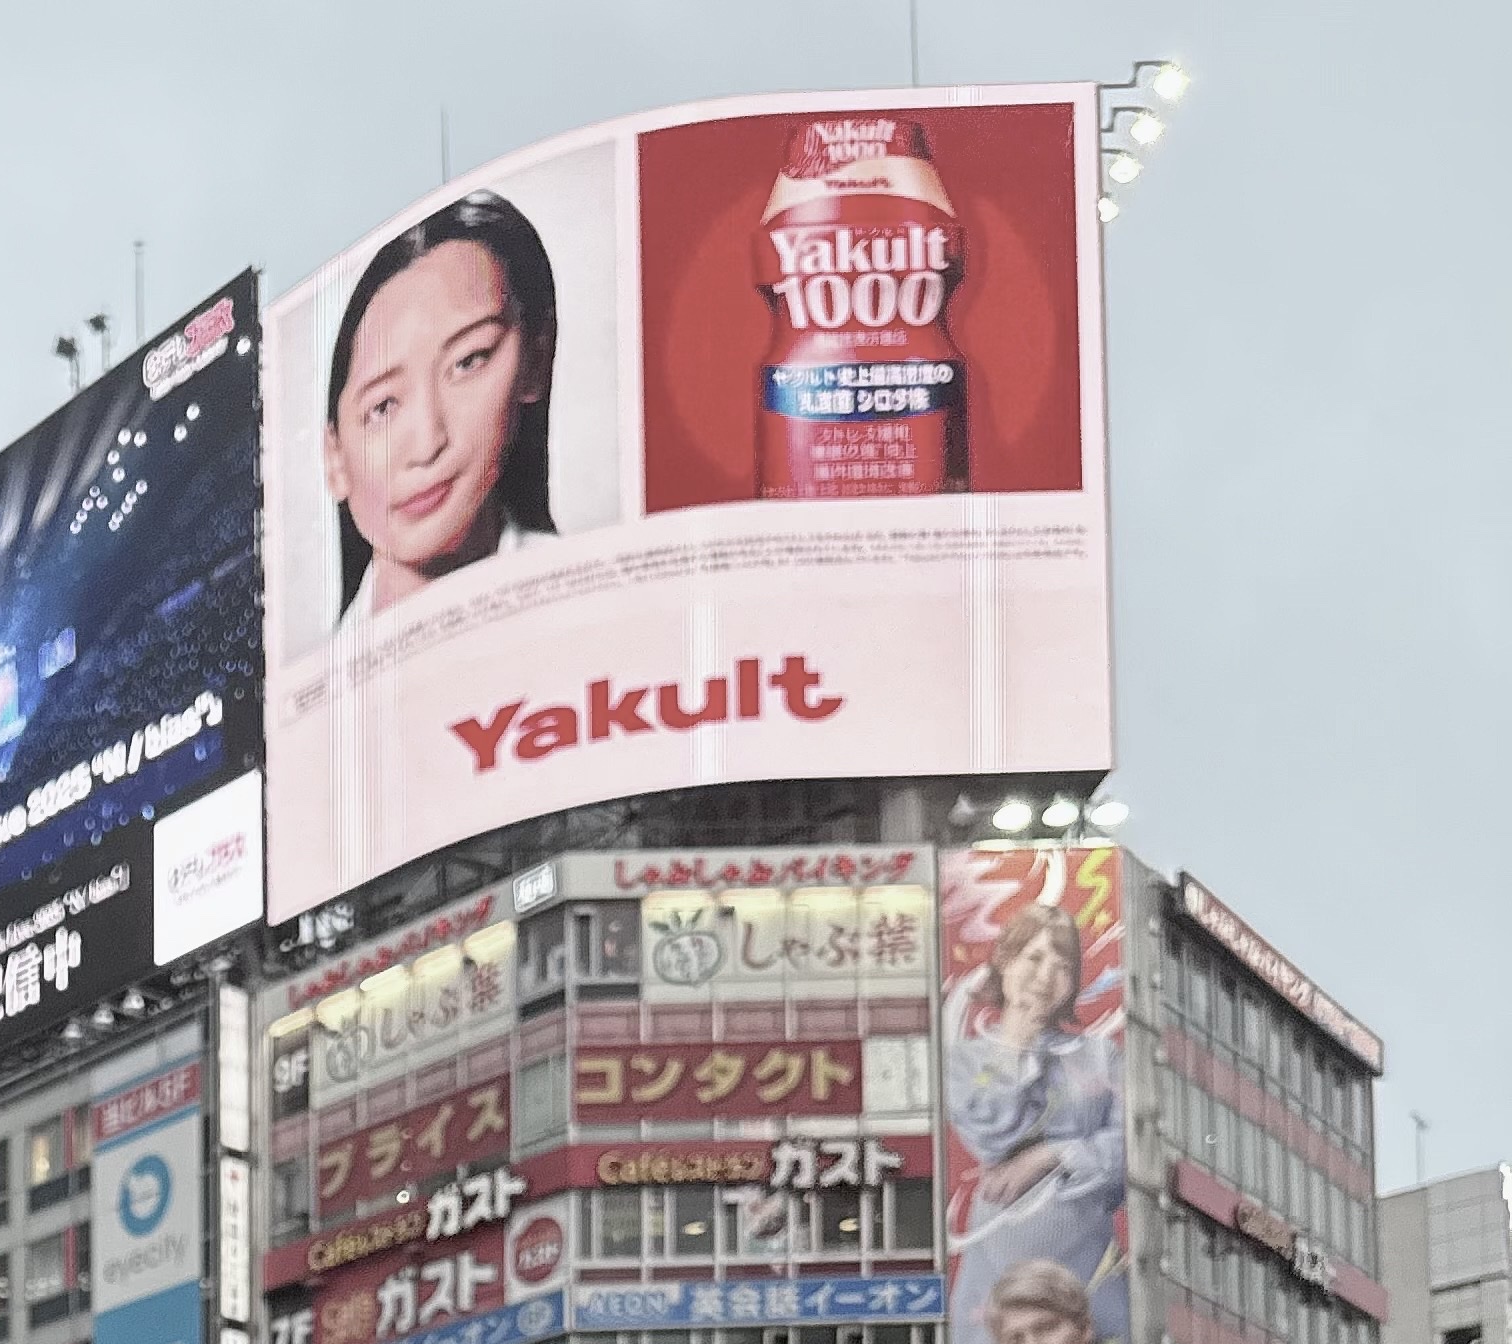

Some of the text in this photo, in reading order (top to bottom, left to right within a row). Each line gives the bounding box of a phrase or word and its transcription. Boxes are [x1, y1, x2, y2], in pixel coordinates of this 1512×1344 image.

[770, 223, 949, 274] Yakult
[772, 271, 944, 329] 1000
[451, 655, 843, 771] Yakult
[741, 911, 918, 972] しゃぶ葉
[576, 1049, 856, 1104] コンタクト
[770, 1138, 906, 1189] ガスト
[426, 1165, 527, 1242] ガスト
[375, 1252, 498, 1340] ガスト
[689, 1282, 938, 1319] 英会話イーオン
